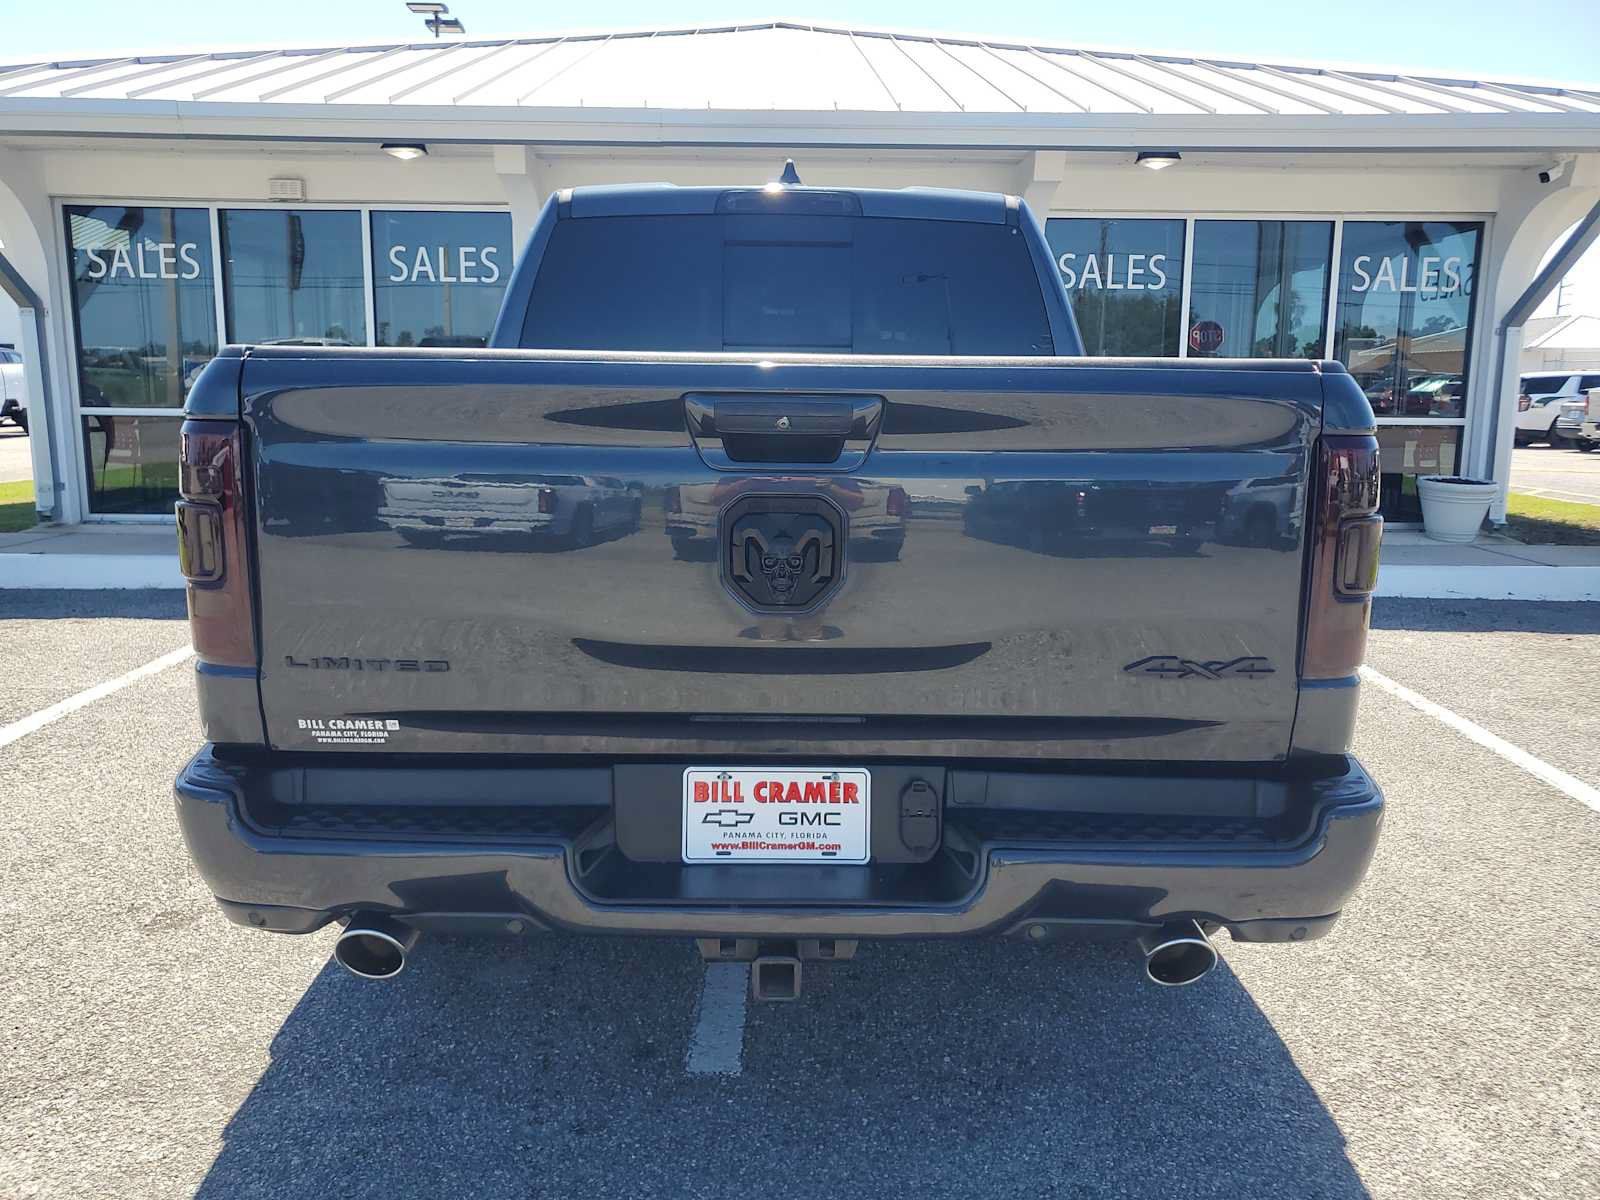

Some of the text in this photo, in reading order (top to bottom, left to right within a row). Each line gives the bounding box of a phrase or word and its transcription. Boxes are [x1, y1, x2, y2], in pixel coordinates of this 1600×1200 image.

[86, 242, 200, 280] SALES
[389, 245, 500, 283] SALES
[1059, 253, 1166, 290] SALES
[1351, 255, 1462, 292] SALES
[285, 655, 450, 672] LIMITED
[298, 719, 325, 730] BILL
[328, 719, 384, 730] CRAMER
[343, 730, 359, 738] CITY,
[693, 781, 860, 804] BILL CRAMER
[778, 812, 841, 826] GMC
[722, 831, 828, 840] PANAMA CITY, FLORIDA
[711, 841, 842, 851] www.BillCramerGM.com
